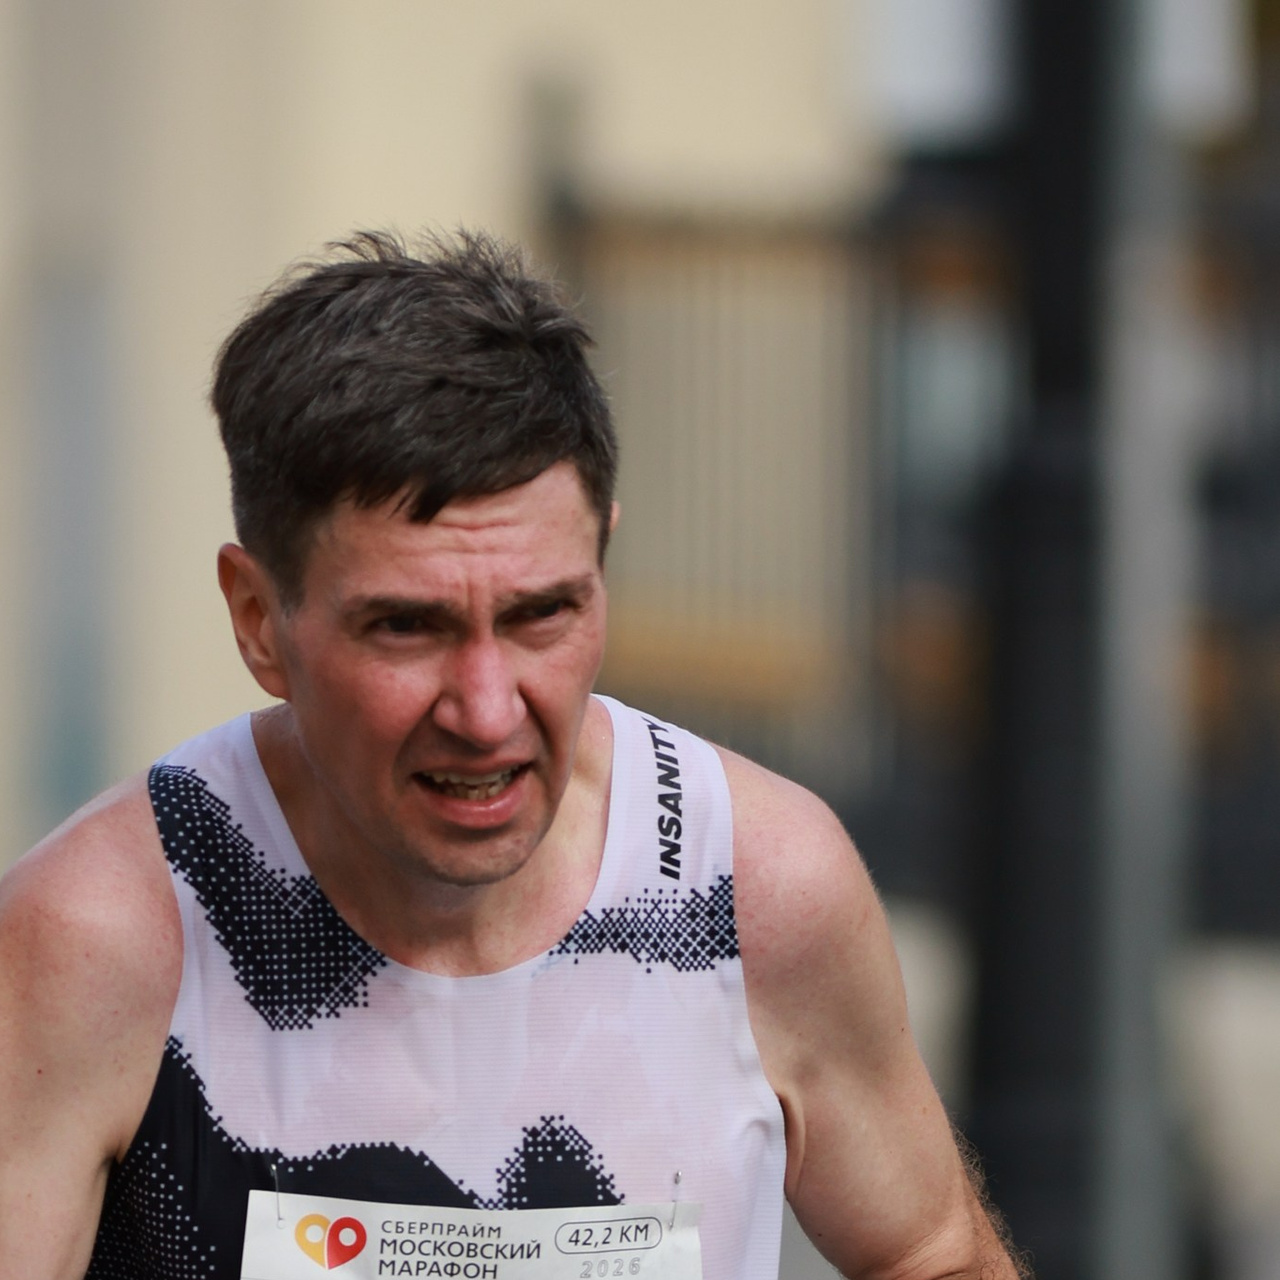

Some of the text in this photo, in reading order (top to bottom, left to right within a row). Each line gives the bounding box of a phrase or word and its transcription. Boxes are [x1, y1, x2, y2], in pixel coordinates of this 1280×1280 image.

[640, 715, 683, 881] INSANITY
[381, 1220, 502, 1239] СБЕРПРАЙМ
[568, 1227, 612, 1249] 42,2
[379, 1238, 541, 1260] МОСКОВСКИЙ
[378, 1259, 498, 1280] МАРАФОН
[579, 1257, 641, 1279] 2026
